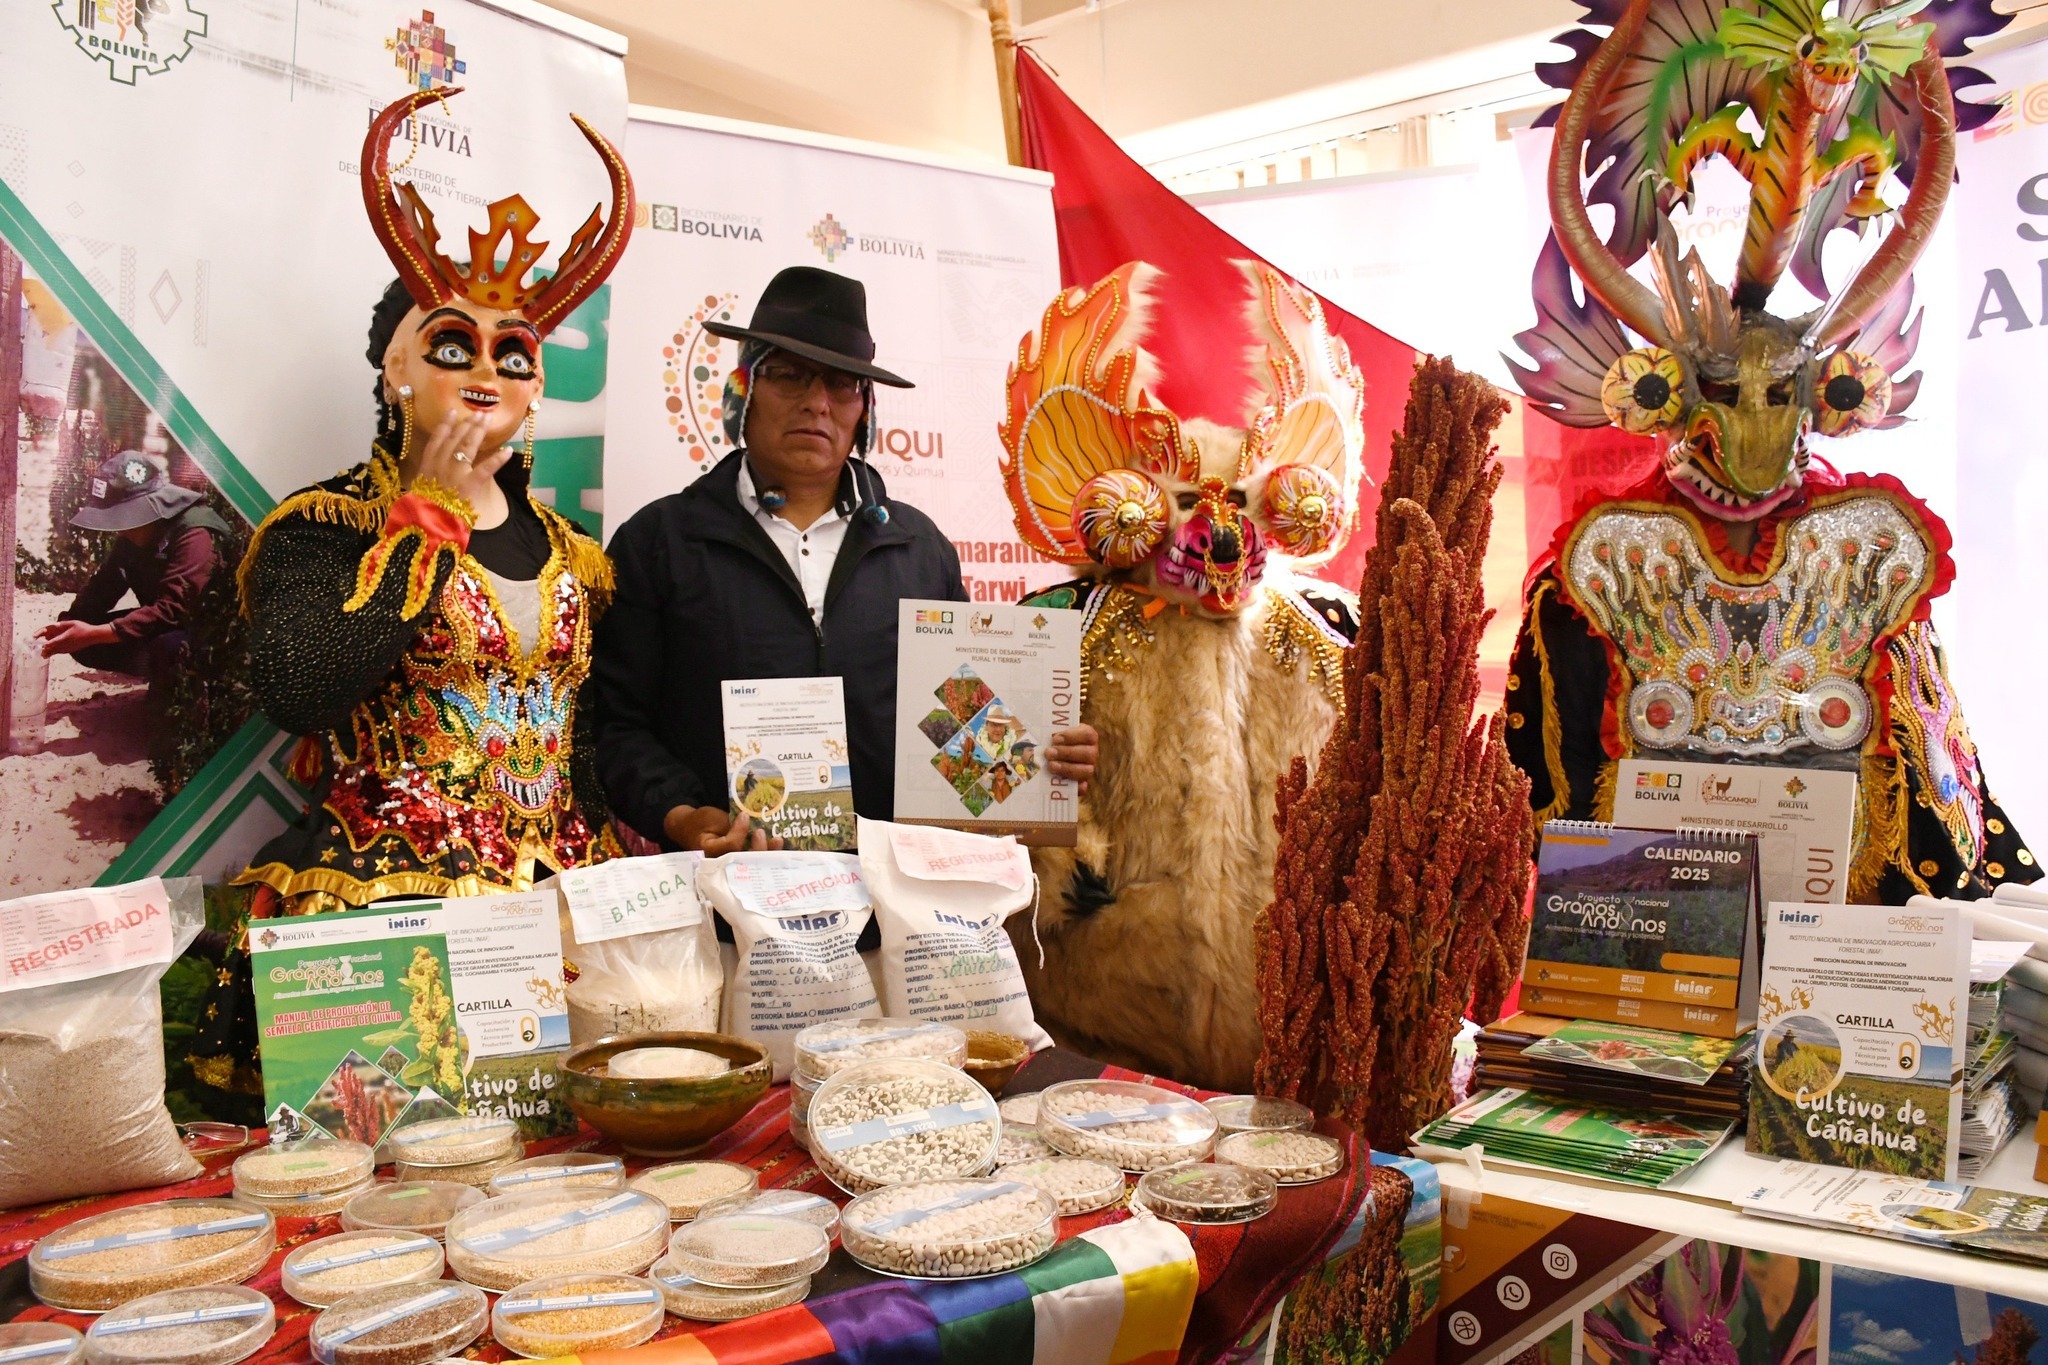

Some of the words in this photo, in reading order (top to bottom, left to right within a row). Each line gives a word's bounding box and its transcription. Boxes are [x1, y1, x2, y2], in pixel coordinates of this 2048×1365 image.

[88, 35, 158, 64] BOLIVIA
[415, 112, 462, 131] RINACIONAL
[444, 175, 457, 187] DE
[446, 190, 453, 198] Y
[1706, 204, 1749, 217] Proye
[682, 219, 763, 243] BOLIVIA
[860, 238, 925, 260] BOLIVIA
[952, 541, 1052, 563] marant
[915, 626, 954, 635] BOLIVIA
[999, 649, 1037, 657] DESARROLLO
[1050, 669, 1072, 801] PRMQUI
[778, 752, 813, 761] CARTILLA
[1634, 791, 1680, 802] BOLIVIA
[1777, 801, 1808, 810] BOLIVIA
[761, 804, 817, 823] Cultivo
[824, 801, 841, 817] de
[772, 820, 839, 838] Cañahua
[1681, 816, 1722, 826] MINISTERIO
[1725, 818, 1735, 826] DE
[1737, 819, 1788, 831] DESARROLLO
[928, 850, 1016, 871] REGISTRADA
[1644, 847, 1741, 864] CALENDARIO
[1671, 866, 1710, 881] 2025
[766, 871, 862, 907] CERTIFICADA
[611, 874, 686, 923] BASICA
[1547, 894, 1616, 917] Granos
[1578, 892, 1621, 904] Proyecto
[1634, 898, 1670, 908] nacional
[9, 903, 160, 976] REGISTRADA
[282, 931, 315, 941] BOLIVIA
[751, 950, 794, 958] PRODUCCIÓN
[820, 942, 838, 952] PARA
[904, 945, 948, 955] PRODUCCIÓN
[750, 958, 774, 966] ORURO,
[904, 954, 930, 963] ORURO,
[270, 965, 336, 983] Granos
[1795, 967, 1827, 975] DESARROLLO
[275, 1010, 310, 1024] MANUAL
[313, 1009, 324, 1019] DE
[326, 1000, 378, 1017] PRODUCCIÓN
[380, 1001, 391, 1011] DE
[457, 999, 512, 1012] CARTILLA
[786, 1010, 808, 1018] BÁSICA
[817, 1005, 850, 1015] REGISTRADA
[909, 1005, 943, 1015] CATEGORÍA:
[944, 1002, 965, 1011] BÁSICA
[266, 1021, 302, 1037] SEMILLA
[304, 1016, 356, 1032] CERTIFICADA
[358, 1014, 370, 1025] DE
[371, 1011, 402, 1024] QUINUA
[781, 1022, 806, 1030] VERANO
[1836, 1014, 1894, 1029] CARTILLA
[1852, 1036, 1890, 1045] Capacitación
[1854, 1060, 1888, 1068] Productores
[466, 1074, 517, 1098] tivo
[529, 1067, 555, 1091] de
[468, 1096, 550, 1118] añahua
[1796, 1086, 1885, 1121] Cultivo
[1897, 1099, 1927, 1126] de
[1806, 1113, 1918, 1151] Cañahua
